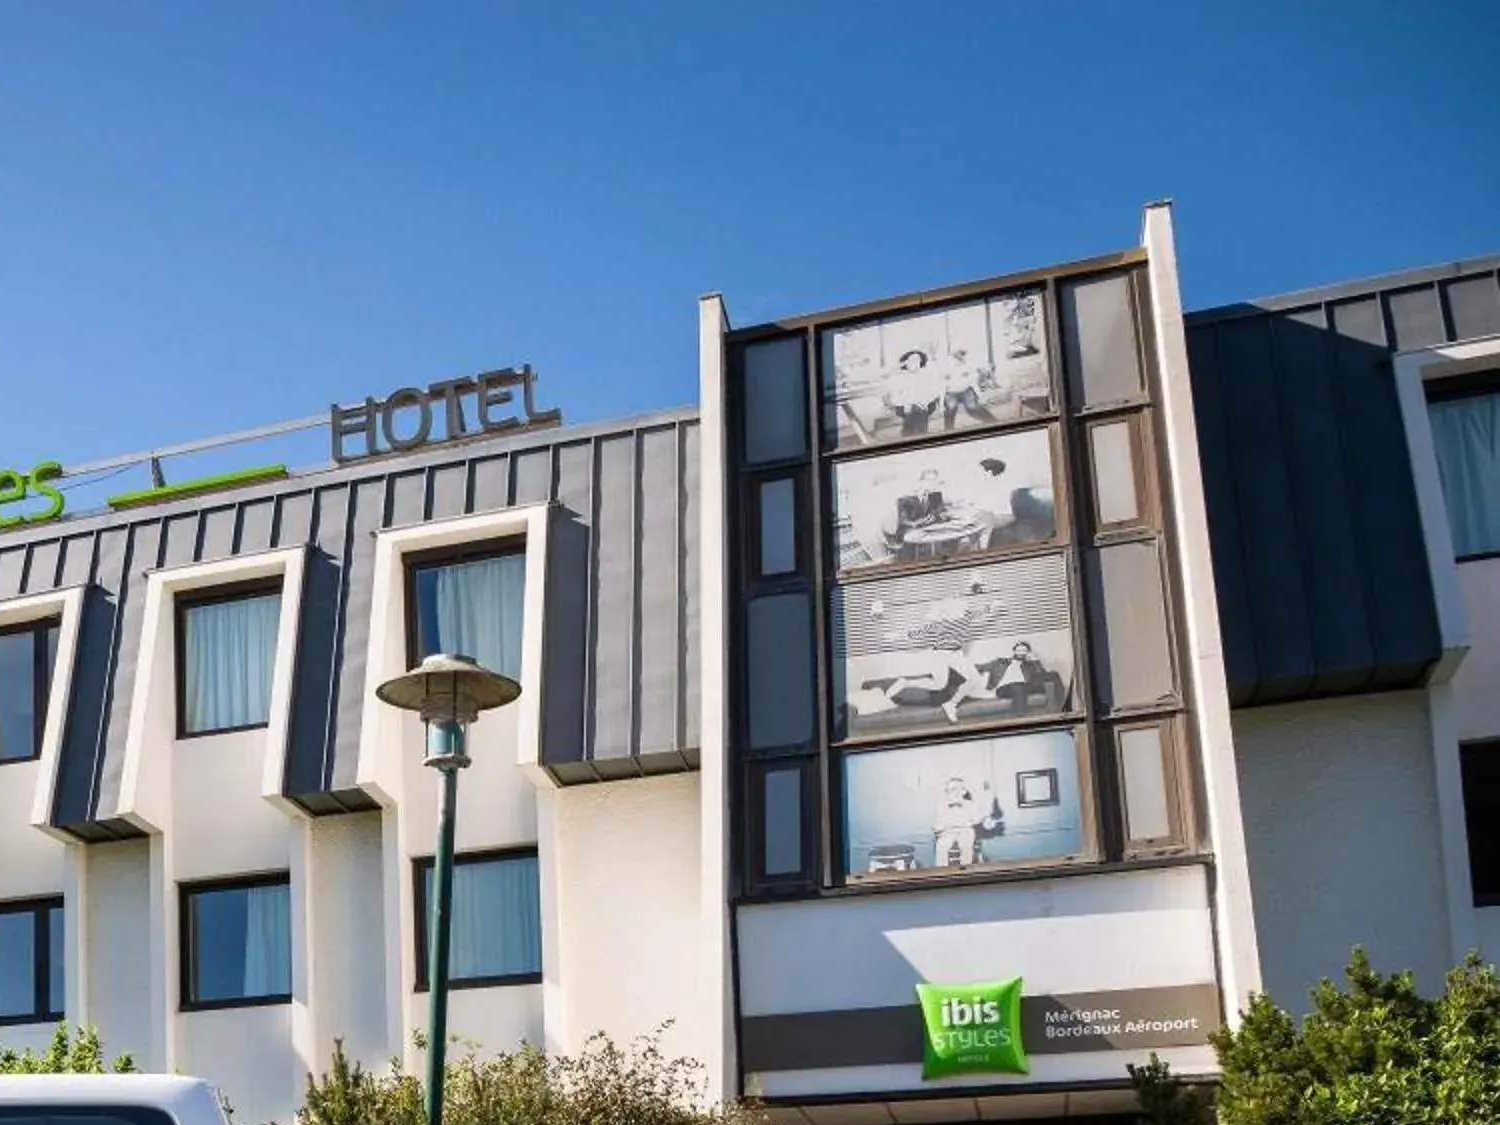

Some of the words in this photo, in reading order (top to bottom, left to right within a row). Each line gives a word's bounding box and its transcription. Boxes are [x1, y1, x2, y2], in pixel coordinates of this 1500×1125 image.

[331, 364, 562, 466] HOTEL
[941, 995, 1000, 1027] ibis
[1045, 1008, 1121, 1023] Mérignac
[1045, 1023, 1121, 1039] Bordeaux
[1125, 1017, 1199, 1034] Aéroport
